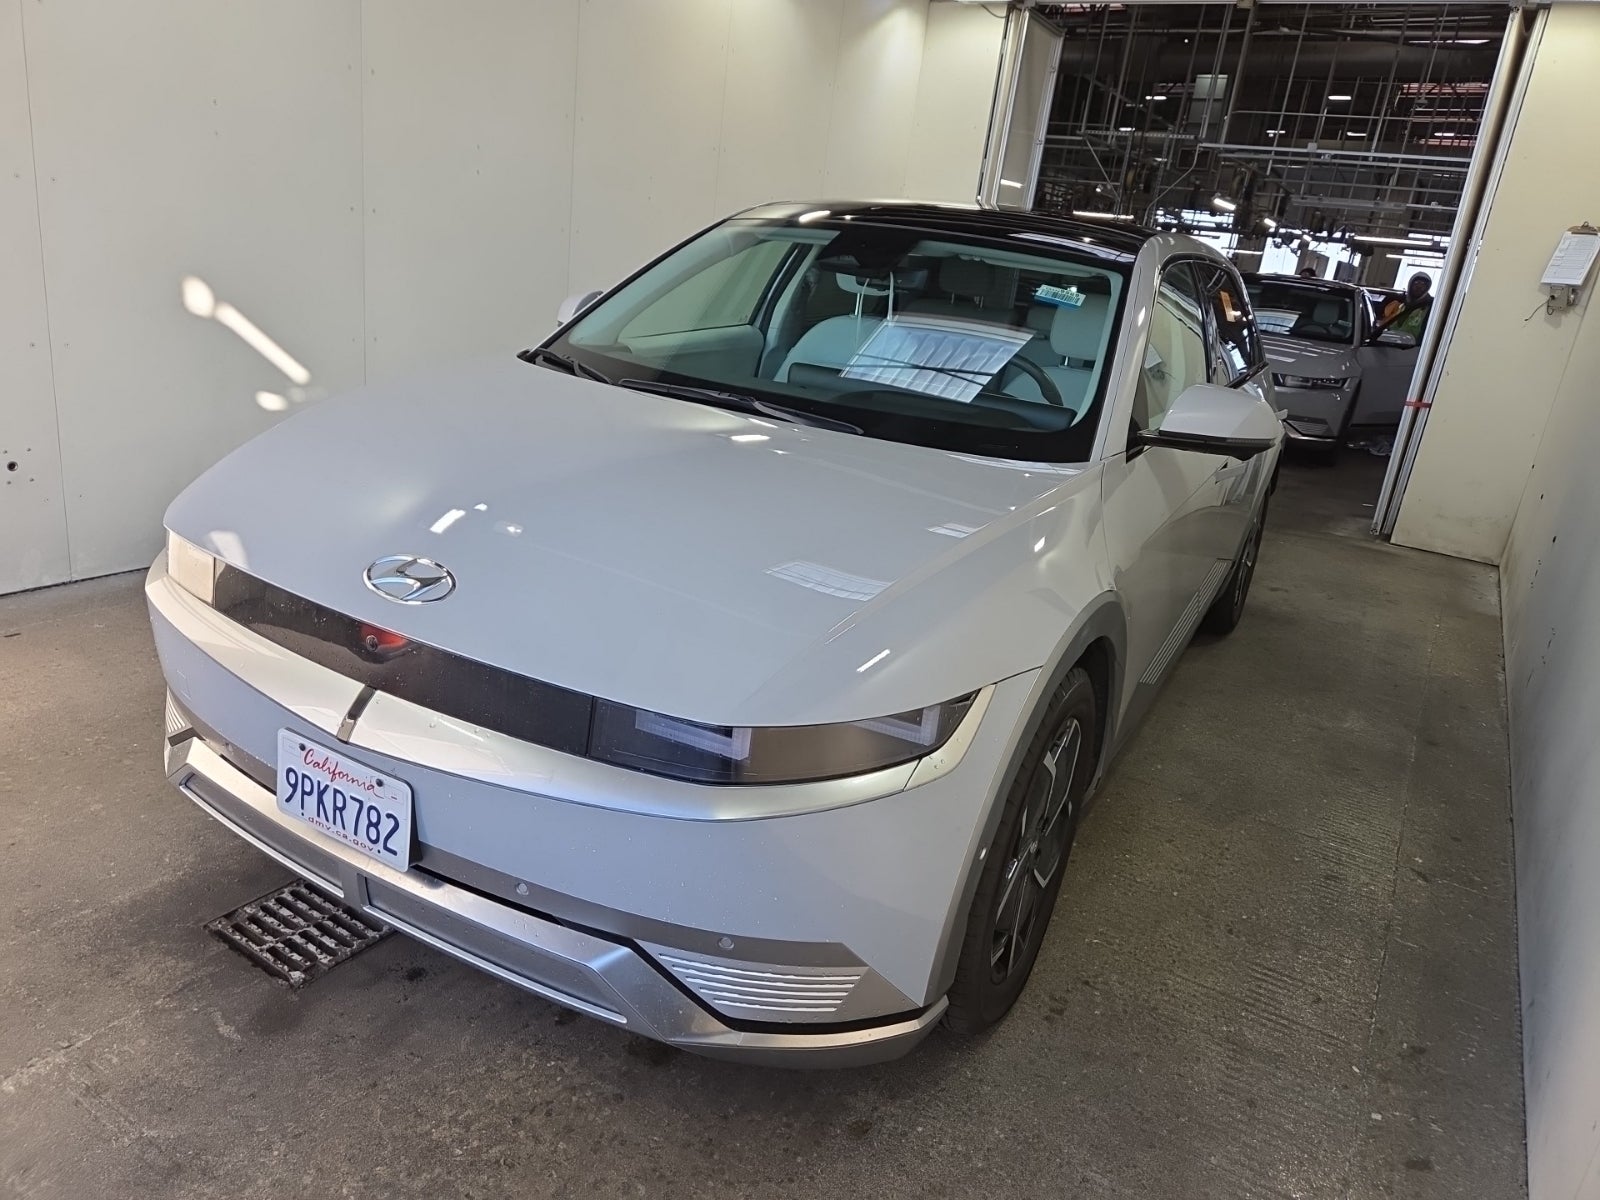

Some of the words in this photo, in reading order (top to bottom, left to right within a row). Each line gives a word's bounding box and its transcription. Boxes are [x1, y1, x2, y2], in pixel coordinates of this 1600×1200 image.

[304, 748, 385, 799] California
[284, 767, 400, 857] 9PKR782
[308, 816, 374, 852] dmv.ca.gov
